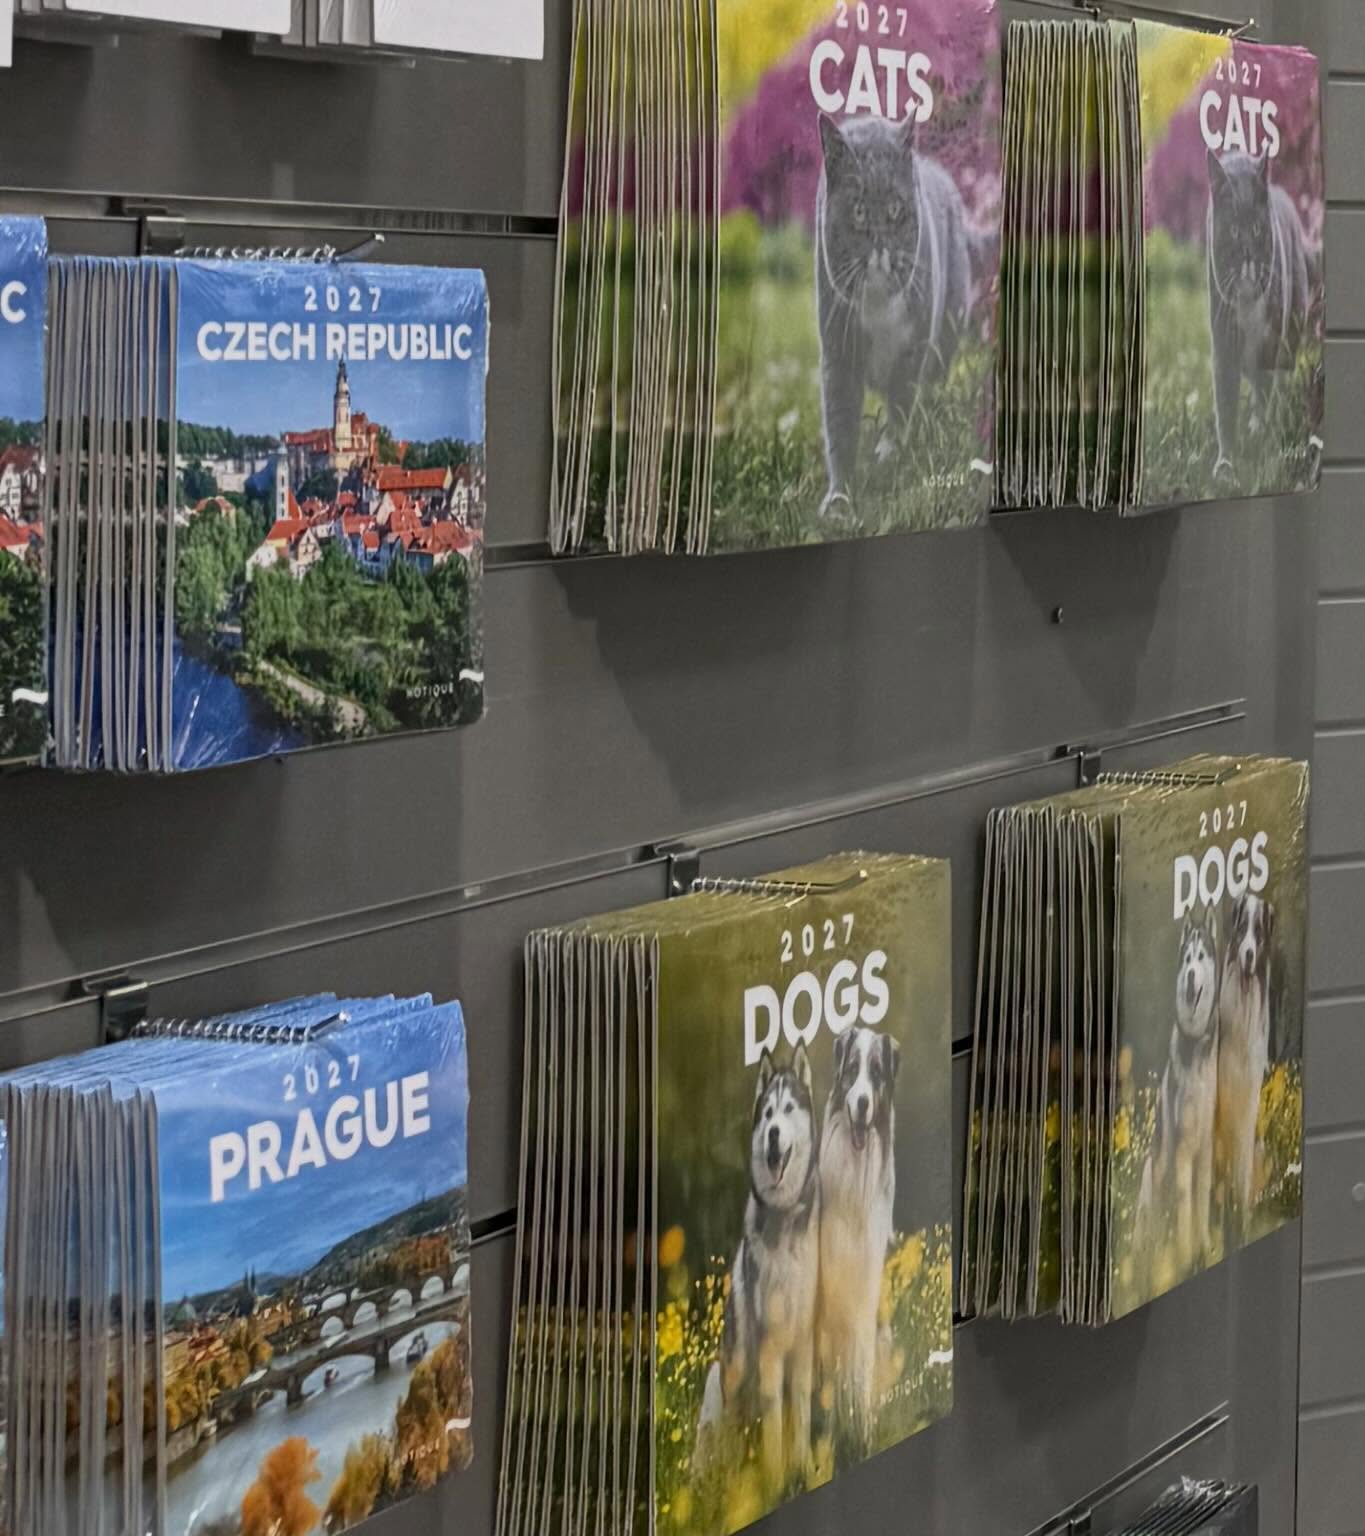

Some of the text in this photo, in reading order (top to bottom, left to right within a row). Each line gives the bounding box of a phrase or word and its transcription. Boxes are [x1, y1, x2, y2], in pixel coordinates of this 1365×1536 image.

[834, 0, 910, 38] 2027
[808, 39, 934, 124] CATS
[1214, 54, 1263, 90] 2027
[1198, 89, 1281, 159] CATS
[304, 286, 382, 313] 2027
[196, 321, 473, 361] CZECH REPUBLIC
[1199, 799, 1248, 836] 2027
[1173, 832, 1269, 920] DOGS
[780, 912, 856, 964] 2027
[743, 949, 891, 1068] DOGS
[282, 1054, 362, 1103] 2027
[208, 1070, 432, 1204] PRAGUE
